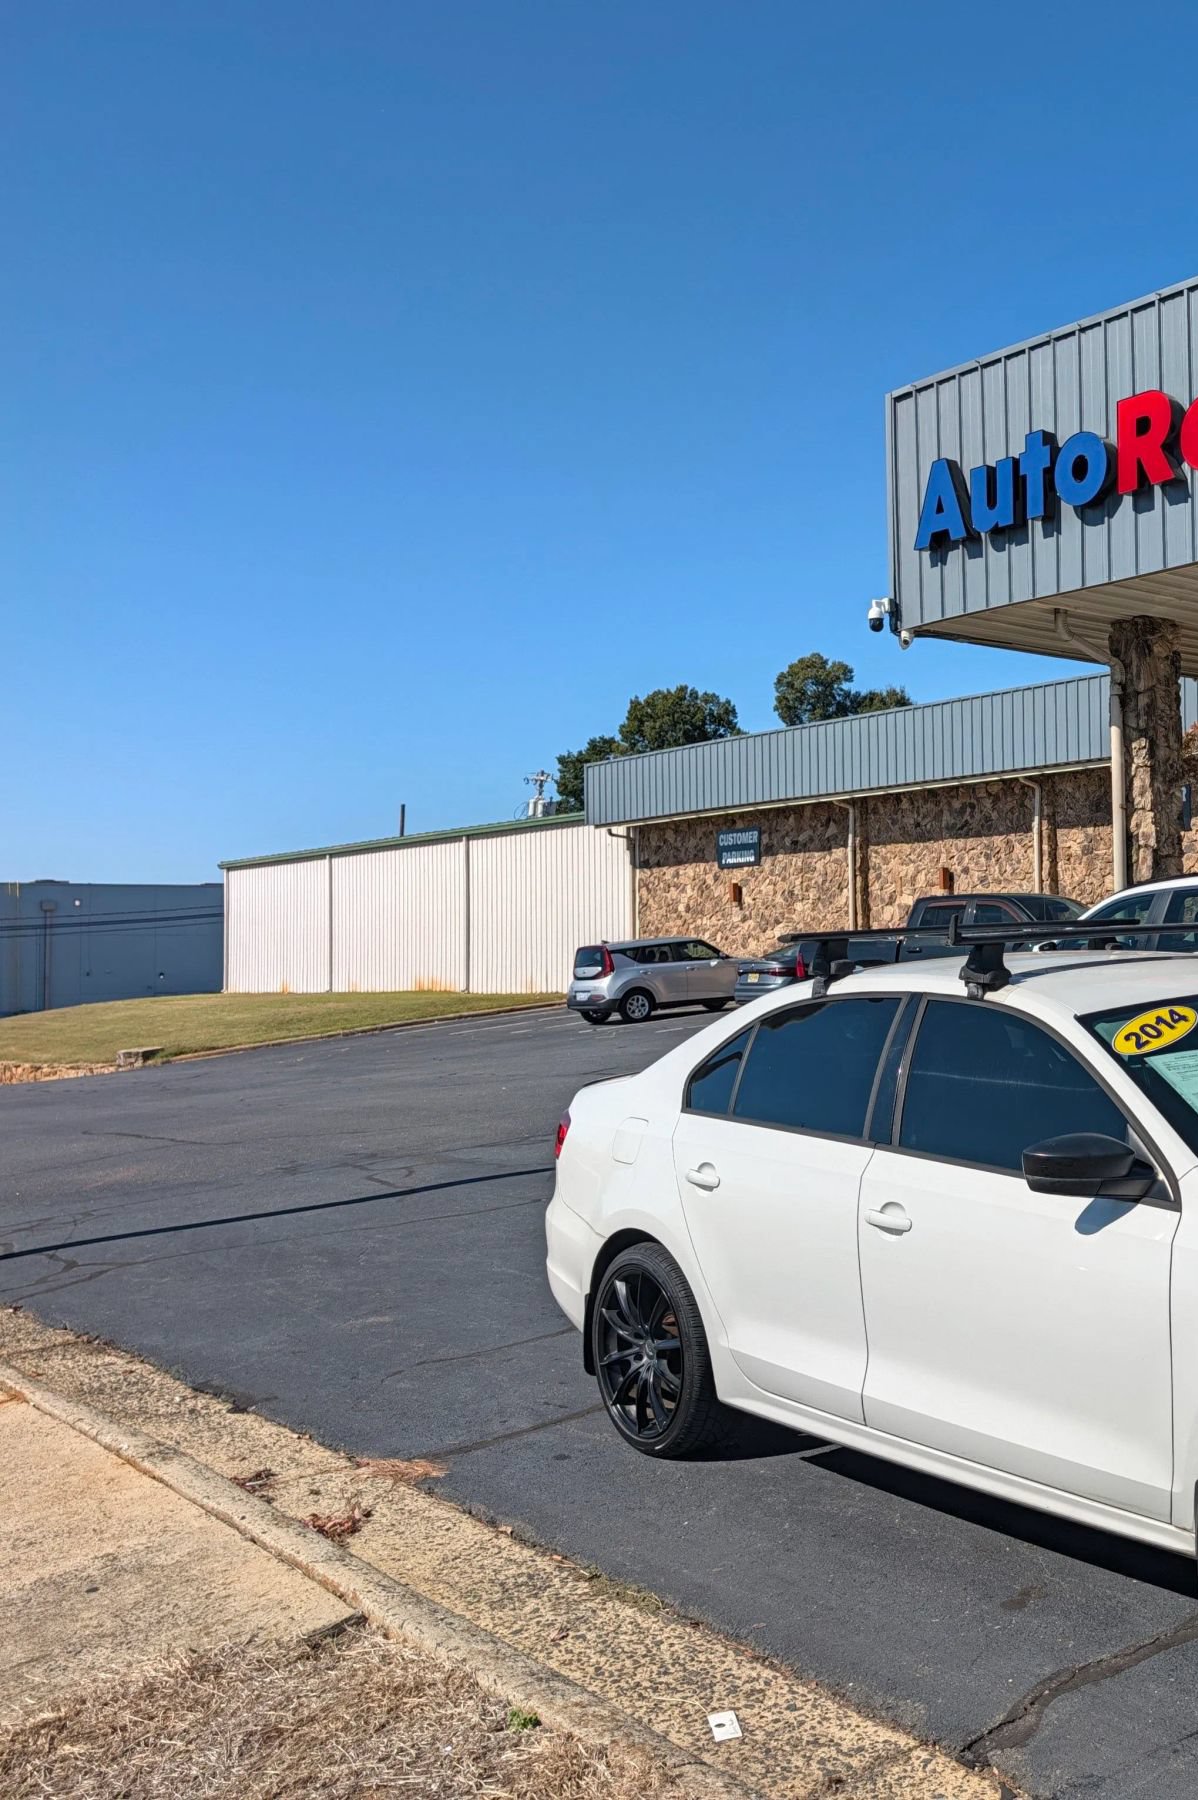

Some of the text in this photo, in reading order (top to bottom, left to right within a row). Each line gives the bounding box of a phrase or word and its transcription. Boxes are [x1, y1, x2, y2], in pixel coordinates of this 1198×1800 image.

[718, 830, 758, 846] CUSTOMER
[721, 849, 755, 865] PARKING
[1123, 1008, 1189, 1051] 2014
